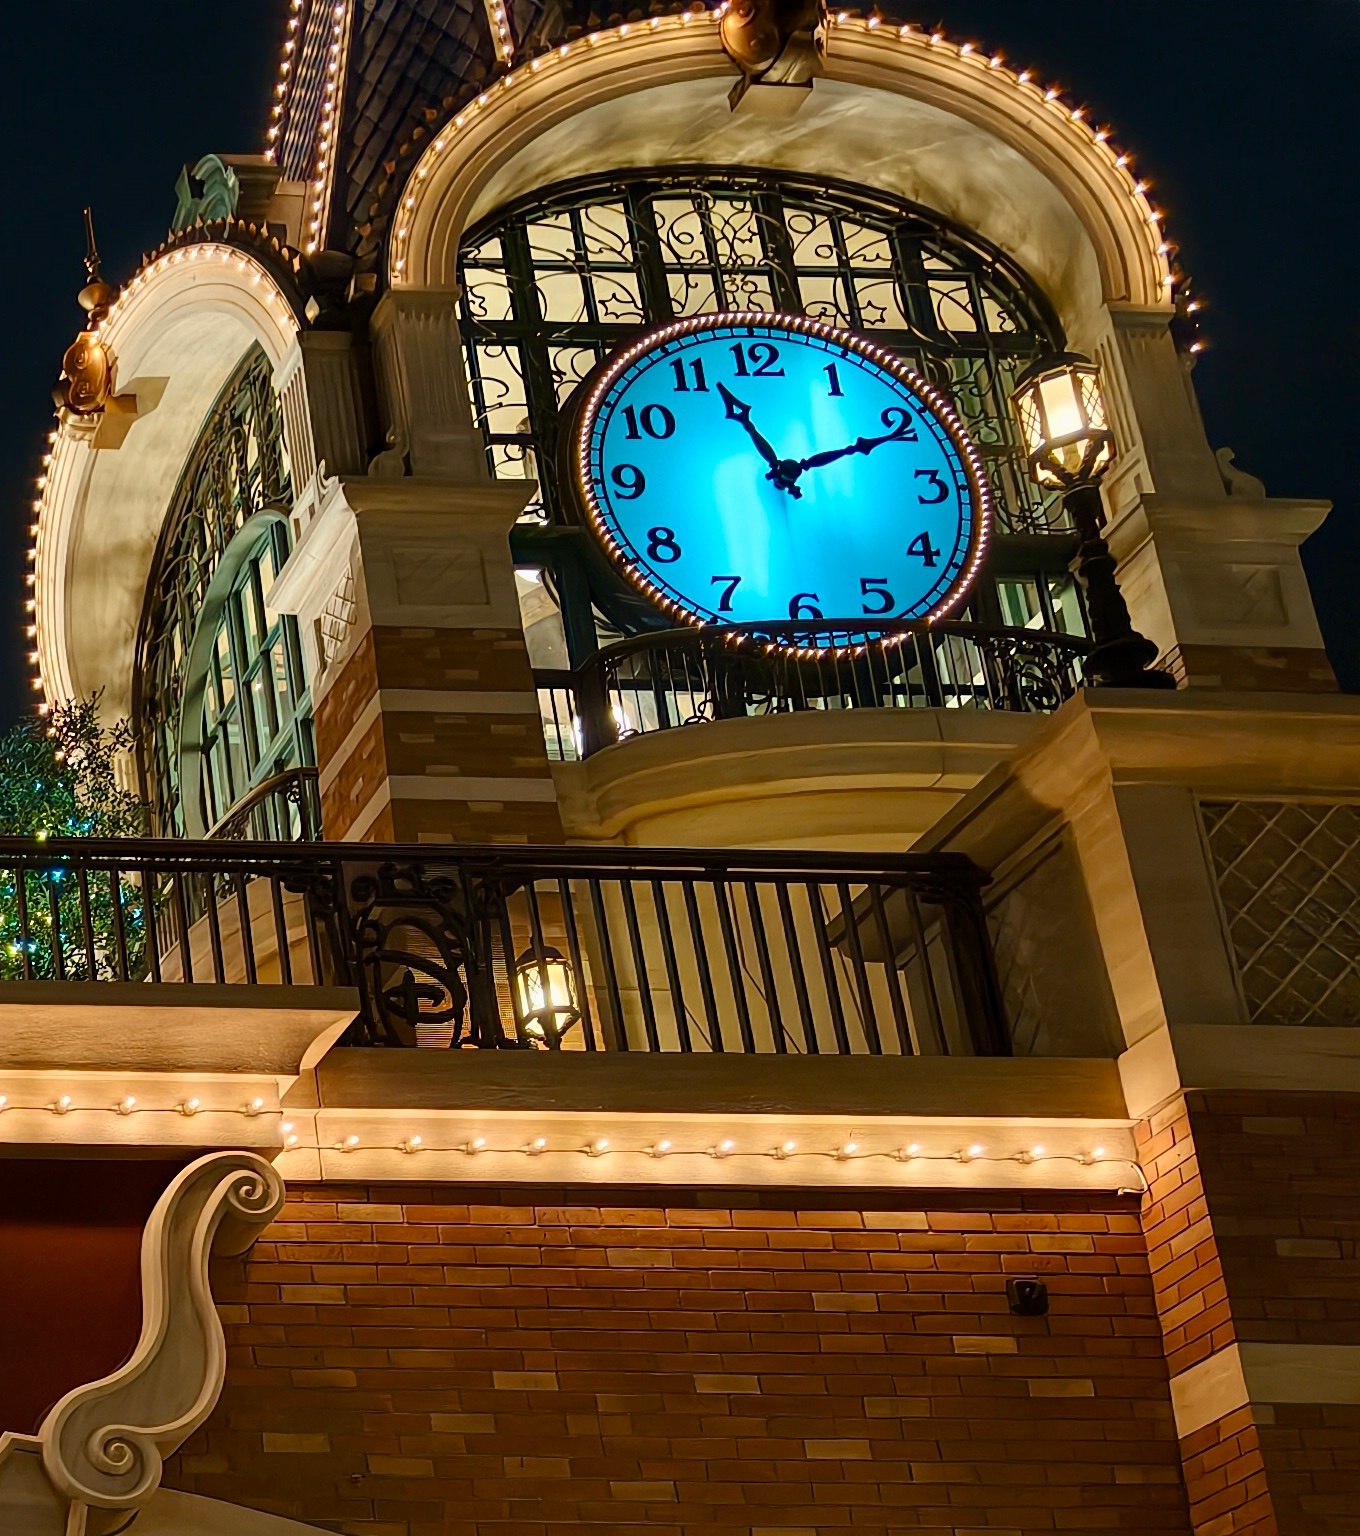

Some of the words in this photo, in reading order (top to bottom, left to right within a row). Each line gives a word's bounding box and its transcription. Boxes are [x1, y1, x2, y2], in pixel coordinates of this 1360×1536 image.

[669, 357, 711, 393] 11
[728, 341, 786, 377] 12
[822, 361, 845, 397] 1
[620, 403, 676, 440] 10
[880, 406, 919, 442] 2
[611, 464, 646, 500] 9
[913, 468, 950, 505] 3
[646, 525, 682, 564] 8
[906, 530, 941, 568] 4
[710, 575, 742, 612] 7
[788, 592, 824, 620] 6
[859, 577, 896, 615] 5
